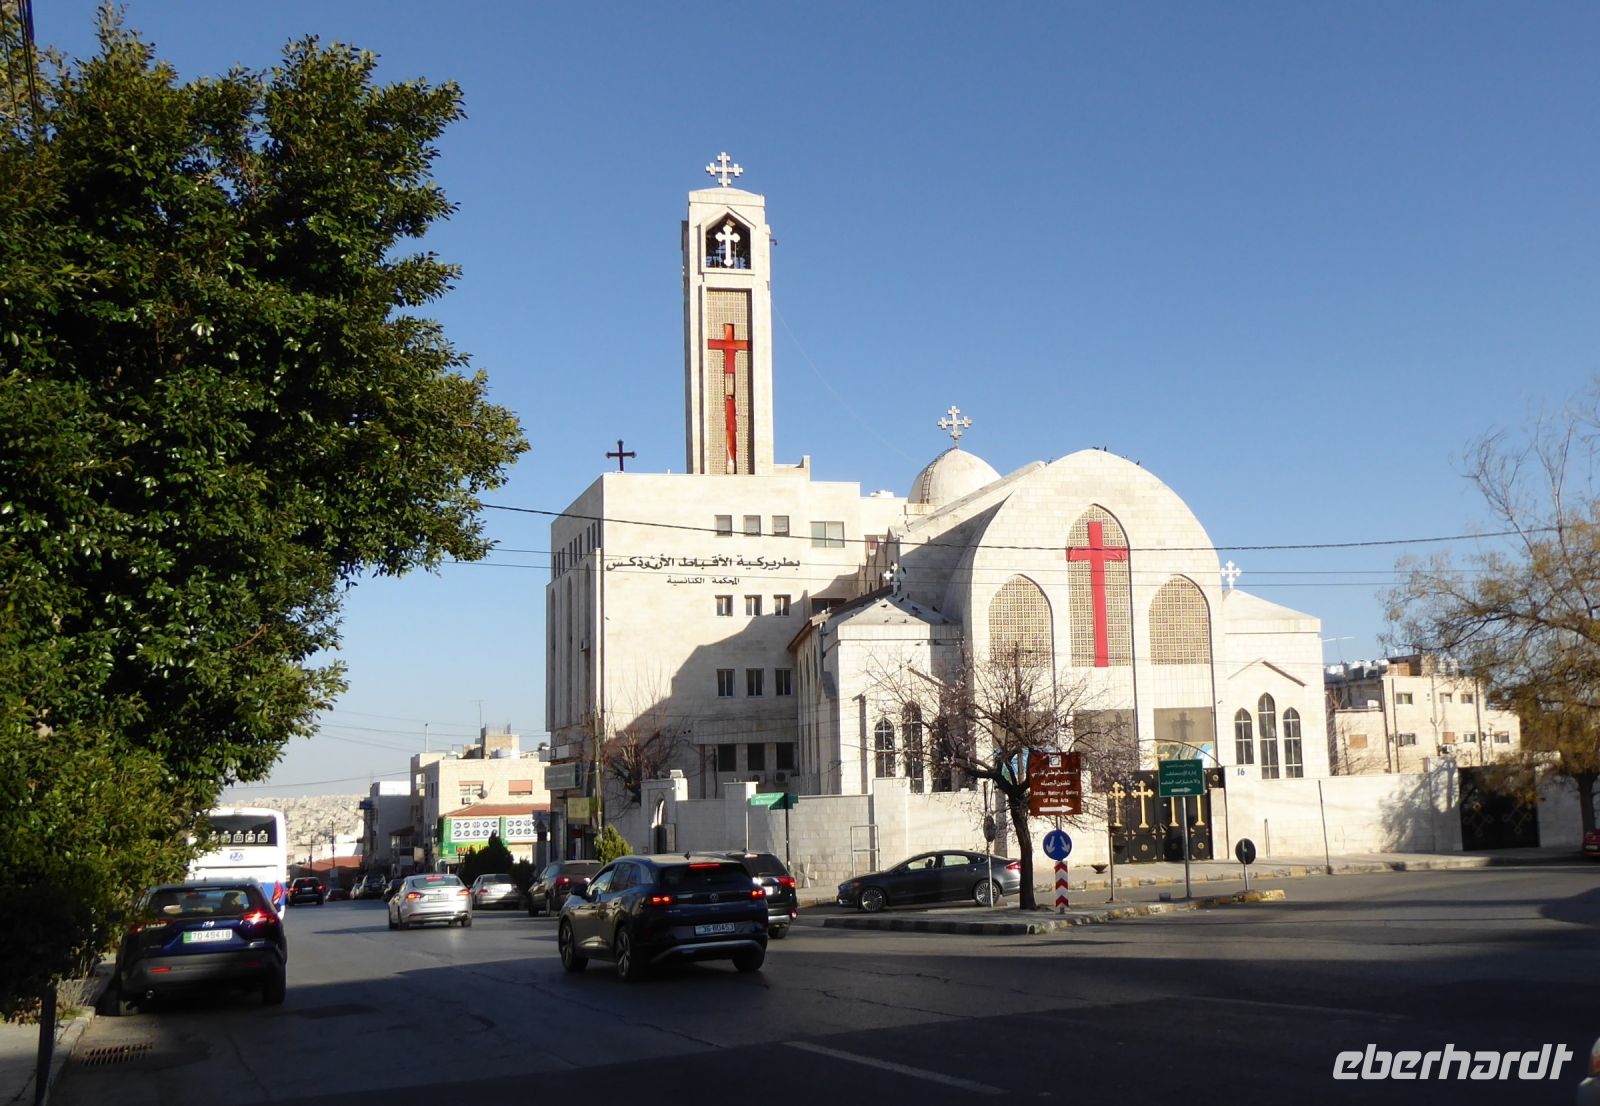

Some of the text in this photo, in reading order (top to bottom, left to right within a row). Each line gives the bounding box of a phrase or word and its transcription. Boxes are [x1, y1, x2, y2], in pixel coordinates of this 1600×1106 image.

[606, 553, 800, 571] بطريركية الأقباط الأرثوذكس
[711, 576, 740, 585] المحكمة
[1237, 768, 1246, 776] 16
